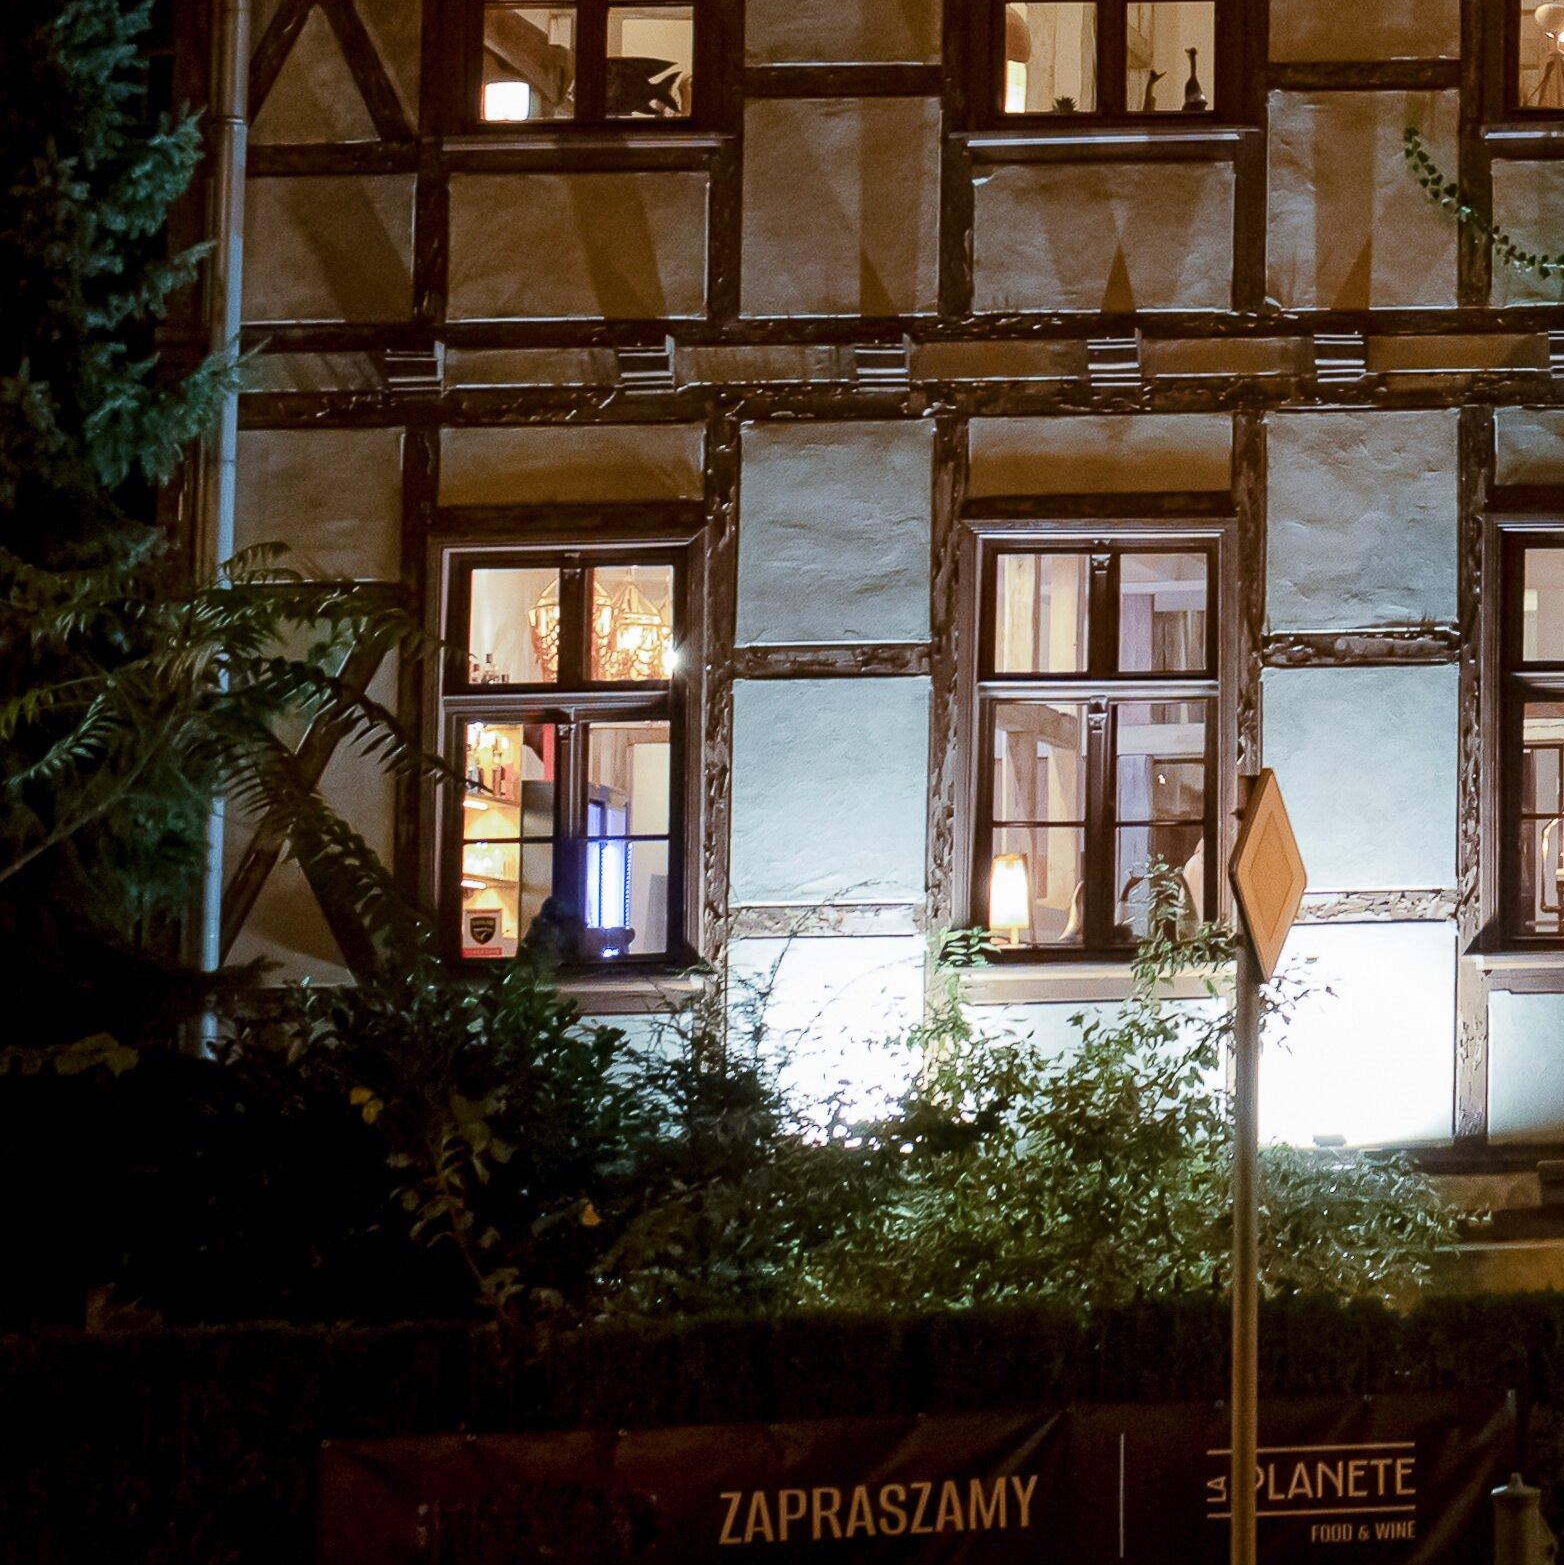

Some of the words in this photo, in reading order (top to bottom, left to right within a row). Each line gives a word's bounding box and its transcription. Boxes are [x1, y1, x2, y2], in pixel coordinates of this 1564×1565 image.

[1256, 1457, 1417, 1502] LANETE
[717, 1474, 1039, 1546] ZAPRASZAMY
[1310, 1525, 1353, 1544] FOOD
[1358, 1524, 1370, 1542] &
[1375, 1520, 1417, 1541] WINE
